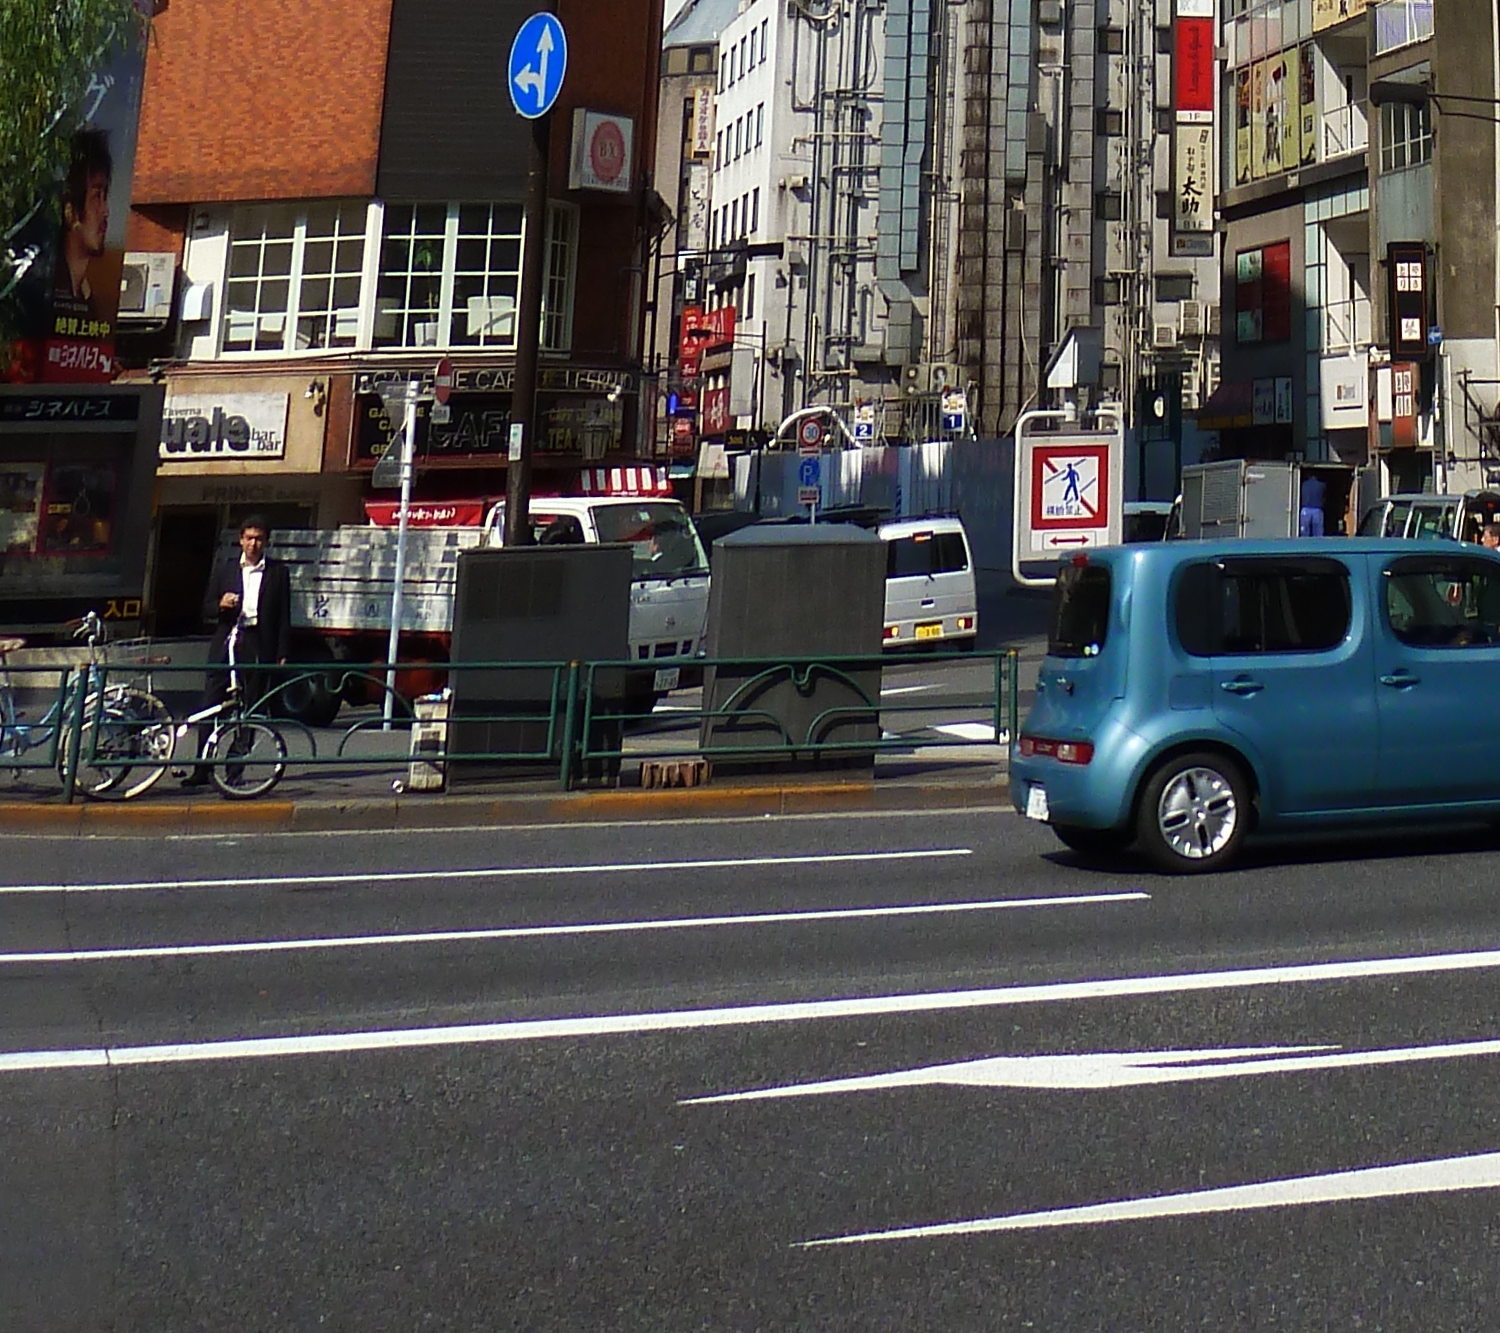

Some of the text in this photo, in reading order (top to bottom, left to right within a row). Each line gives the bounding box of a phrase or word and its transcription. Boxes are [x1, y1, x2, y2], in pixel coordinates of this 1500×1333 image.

[1181, 177, 1202, 214] 太助
[55, 317, 110, 339] 絶賛上映中
[476, 370, 516, 391] CAF
[432, 410, 518, 450] CAF
[859, 424, 868, 436] 2
[949, 416, 957, 428] 1
[252, 428, 276, 441] bar
[257, 438, 282, 451] bar
[104, 599, 141, 618] 入口
